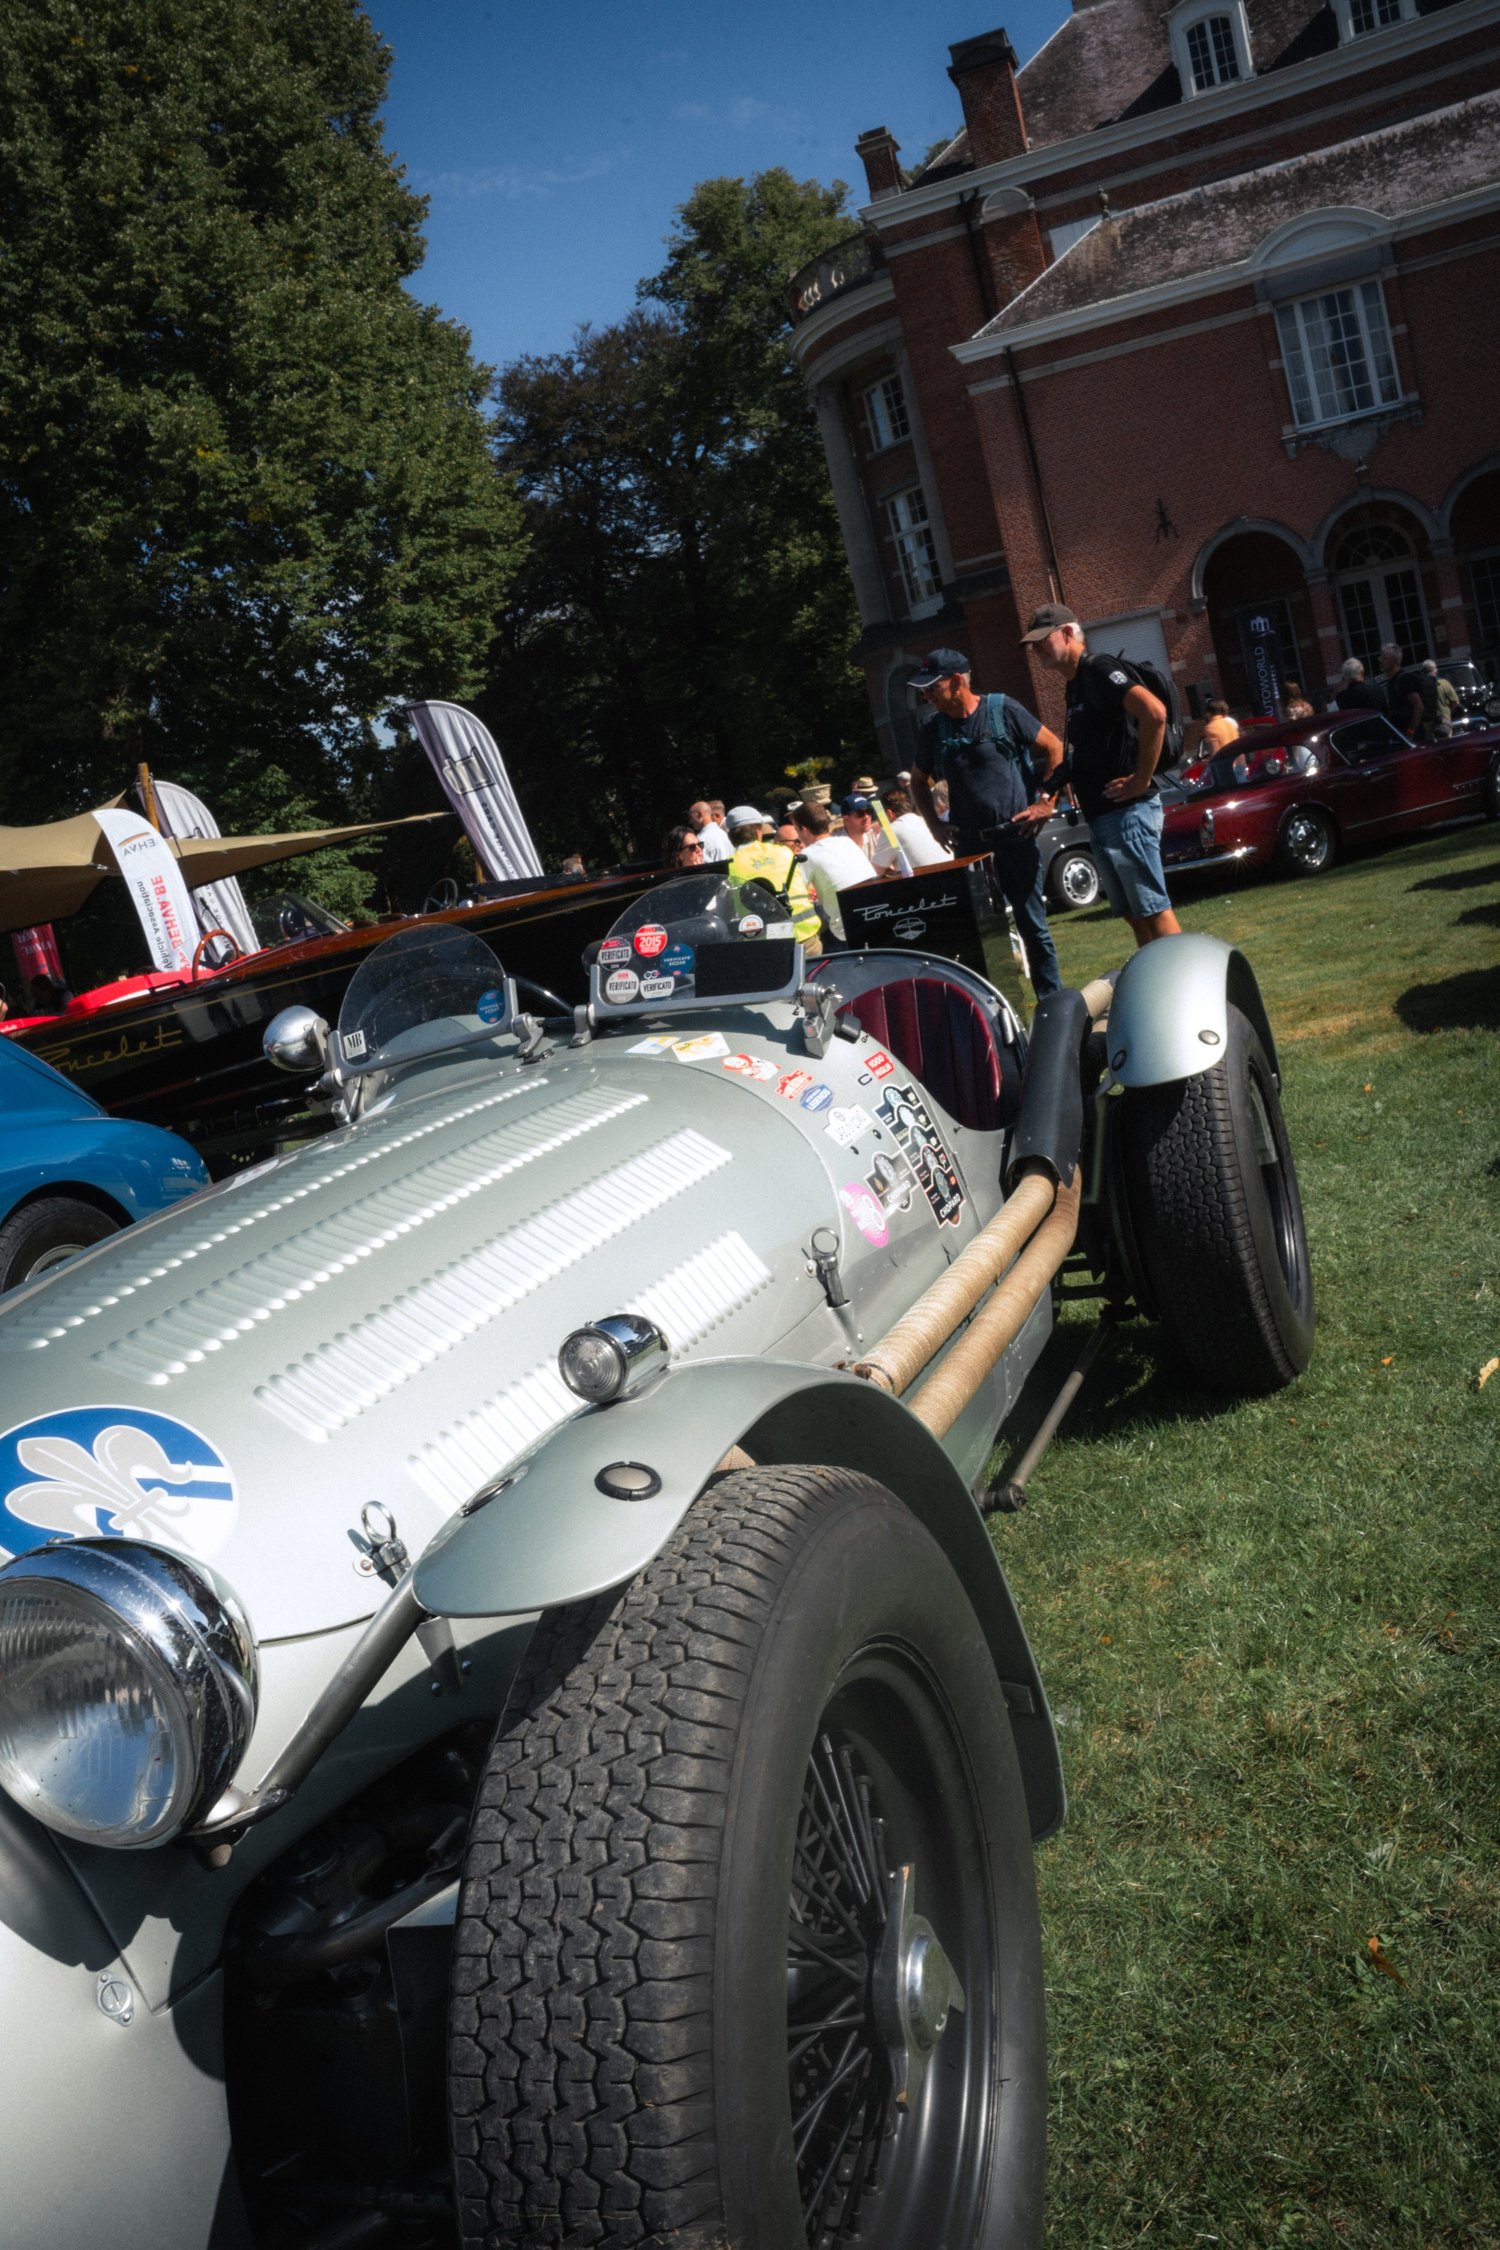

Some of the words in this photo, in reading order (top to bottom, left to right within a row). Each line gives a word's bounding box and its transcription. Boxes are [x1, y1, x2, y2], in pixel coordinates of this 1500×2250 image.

[1254, 646, 1274, 717] UTOWORLD
[852, 893, 958, 921] Poncelet
[640, 935, 661, 948] 2015
[602, 949, 630, 961] VERIFICATO
[608, 981, 637, 991] VERIFICATO
[643, 981, 672, 992] VERIFICATO
[347, 1033, 363, 1048] MB
[939, 1192, 961, 1219] CHOPARD
